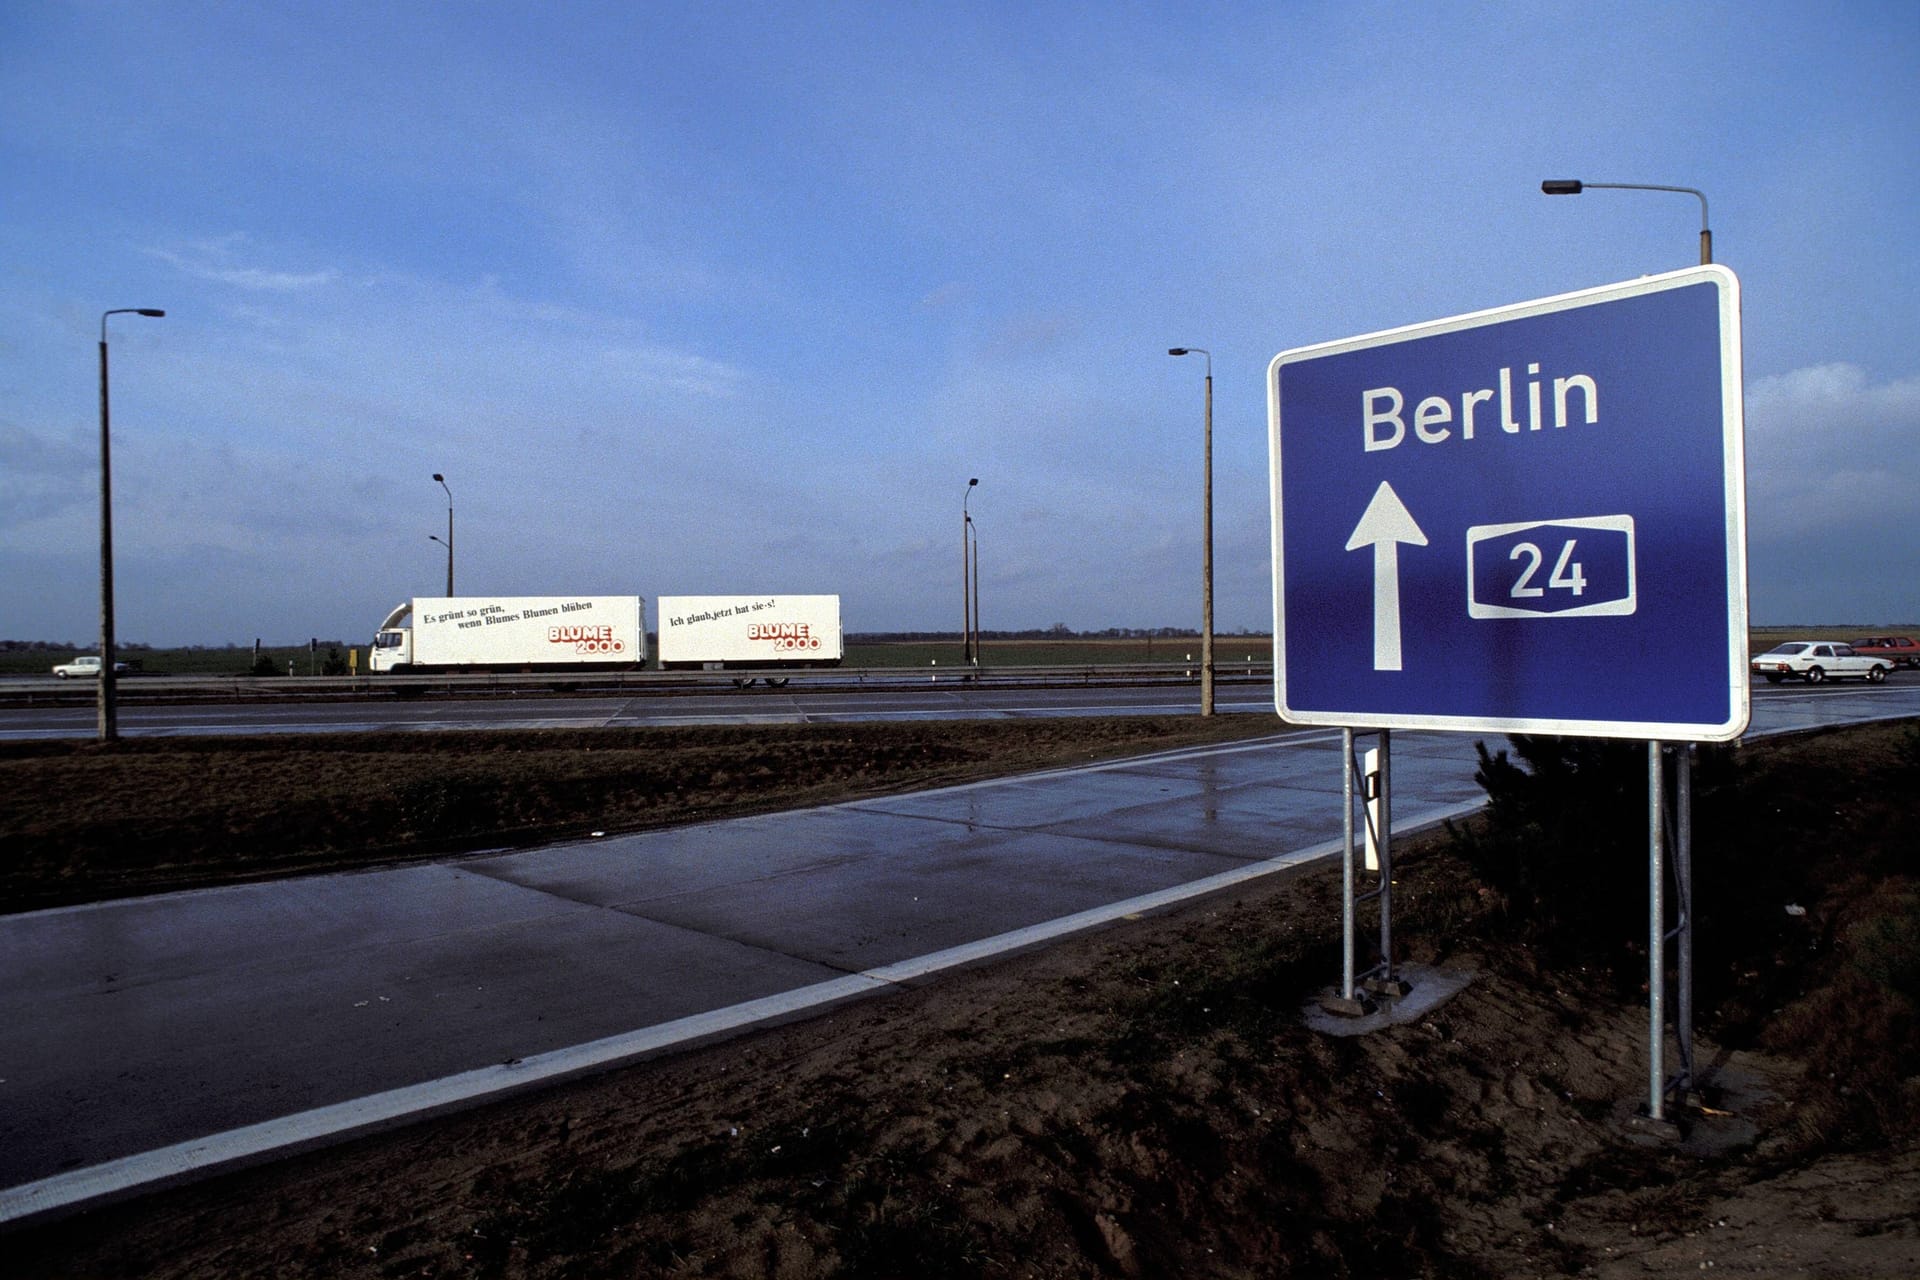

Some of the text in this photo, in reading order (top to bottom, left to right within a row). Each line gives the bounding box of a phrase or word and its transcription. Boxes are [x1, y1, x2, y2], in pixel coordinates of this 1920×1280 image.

[1363, 362, 1598, 452] Berlin
[1509, 539, 1587, 598] 24
[424, 604, 505, 624] Es grünt so grün,
[458, 601, 592, 629] wenn Blumes Blumen blühen
[670, 616, 684, 626] Ich
[735, 604, 749, 614] hat
[548, 625, 612, 643] BLUME
[747, 622, 809, 640] BLUME
[576, 639, 625, 654] 2000
[774, 636, 822, 651] 2000
